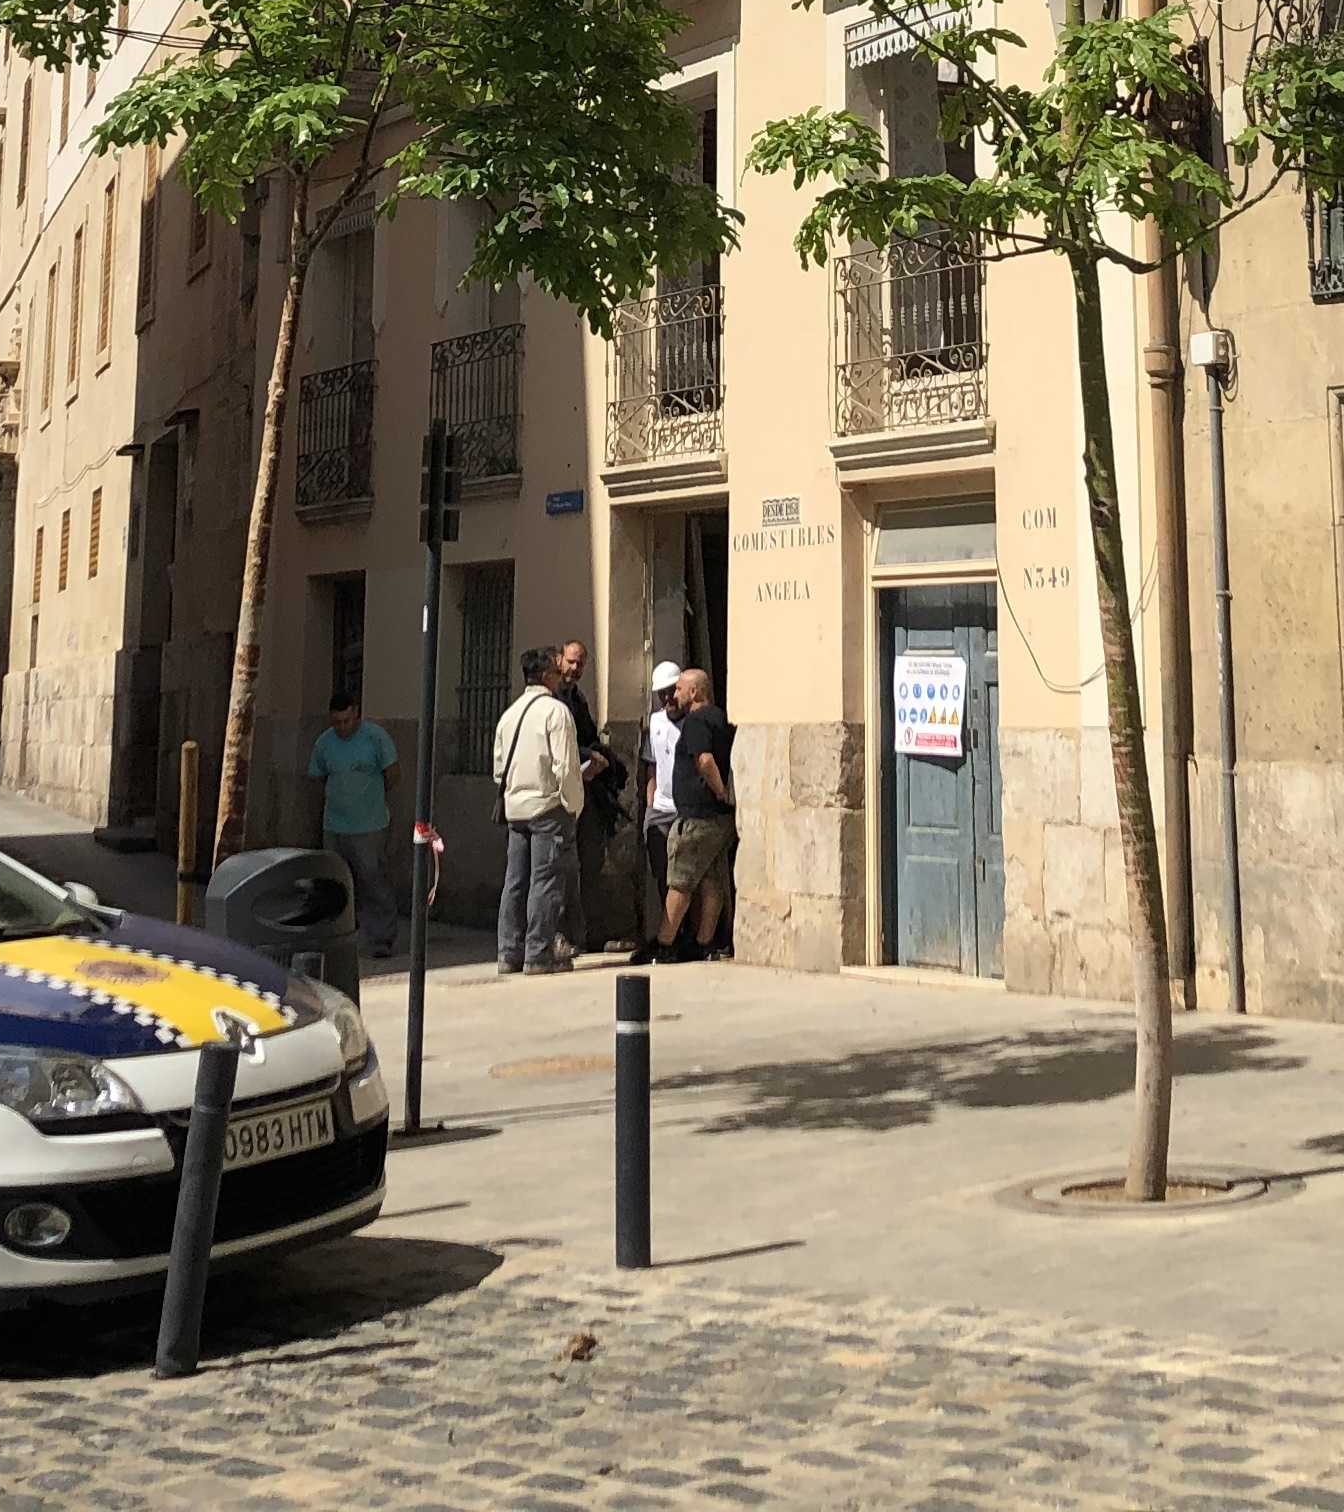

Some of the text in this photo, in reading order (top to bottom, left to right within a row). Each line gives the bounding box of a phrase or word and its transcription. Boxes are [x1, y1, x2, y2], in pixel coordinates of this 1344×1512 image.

[1022, 506, 1056, 530] COM
[733, 523, 836, 552] COMESTIBLES
[755, 579, 811, 603] ANGELA
